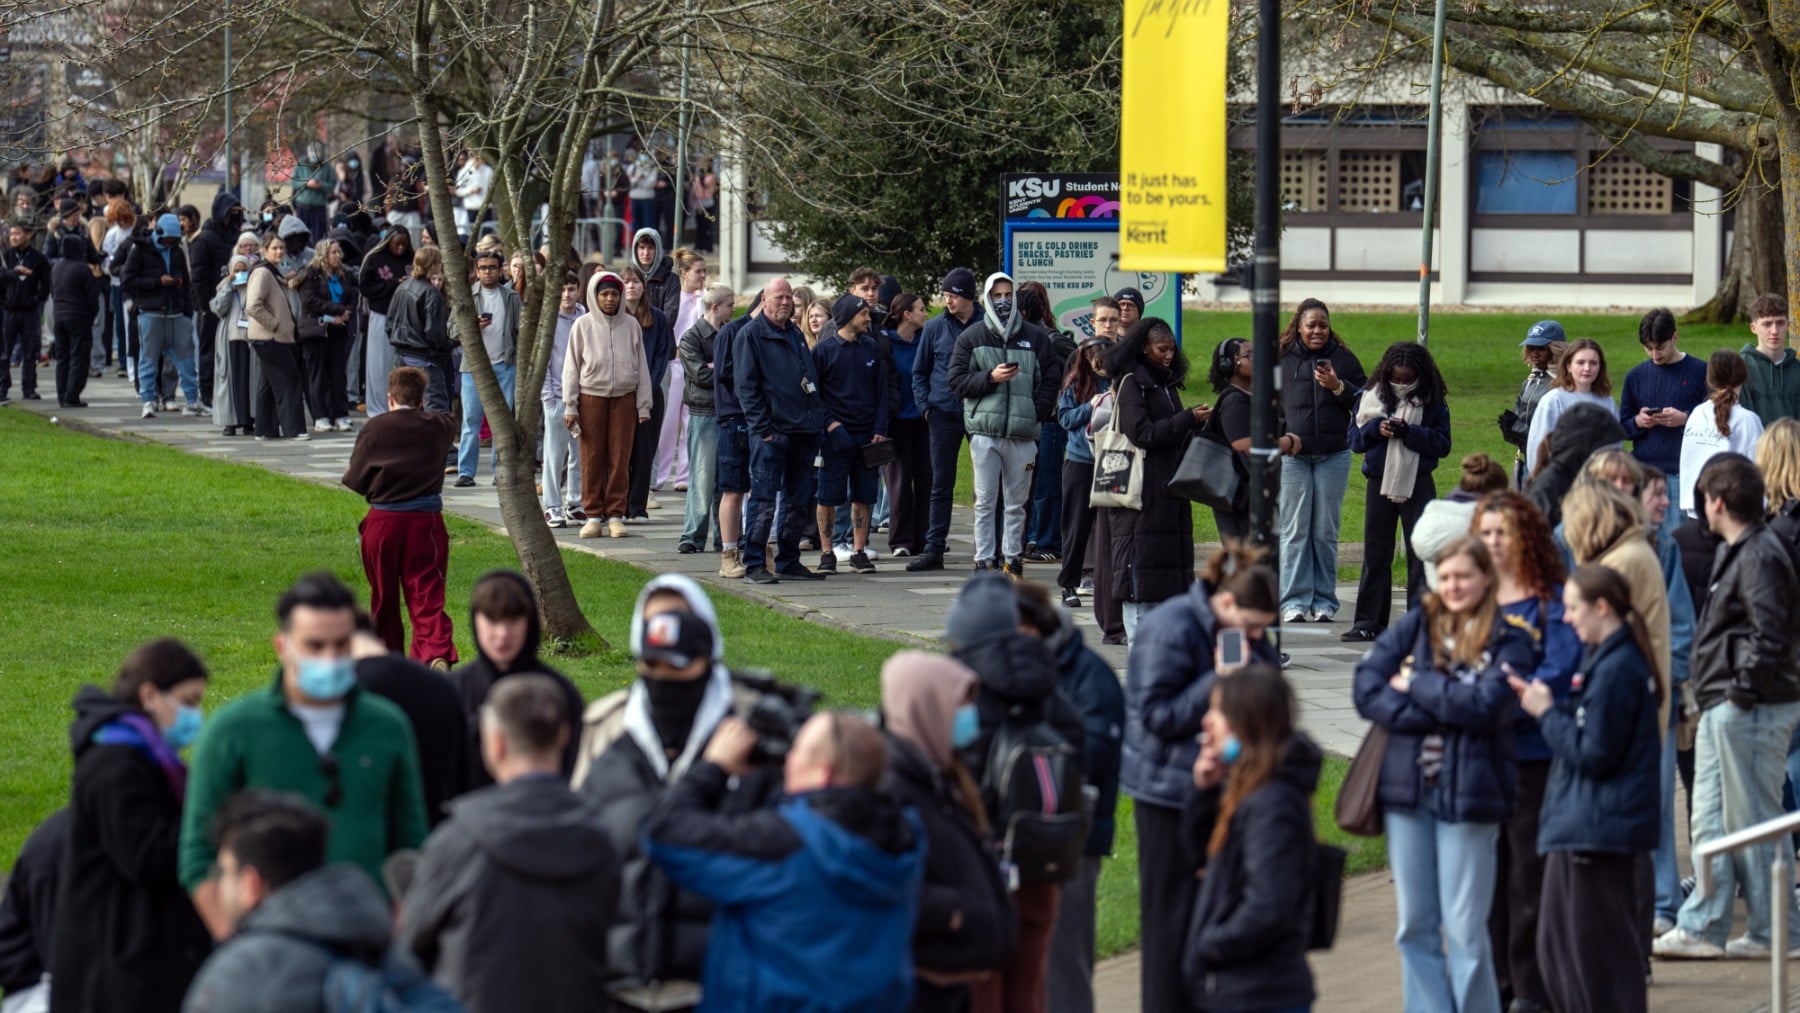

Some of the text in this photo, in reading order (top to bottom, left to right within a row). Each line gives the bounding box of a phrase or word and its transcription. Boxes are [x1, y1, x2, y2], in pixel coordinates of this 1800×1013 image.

[1009, 177, 1060, 198] KSU
[1065, 182, 1108, 192] Student
[1127, 173, 1197, 190] It just has
[1127, 192, 1212, 208] to be yours.
[1126, 227, 1168, 244] Kent
[1018, 242, 1098, 250] HOT & COLD DRINKS
[1055, 250, 1094, 258] PASTRIES
[1018, 259, 1054, 267] & LUNCH
